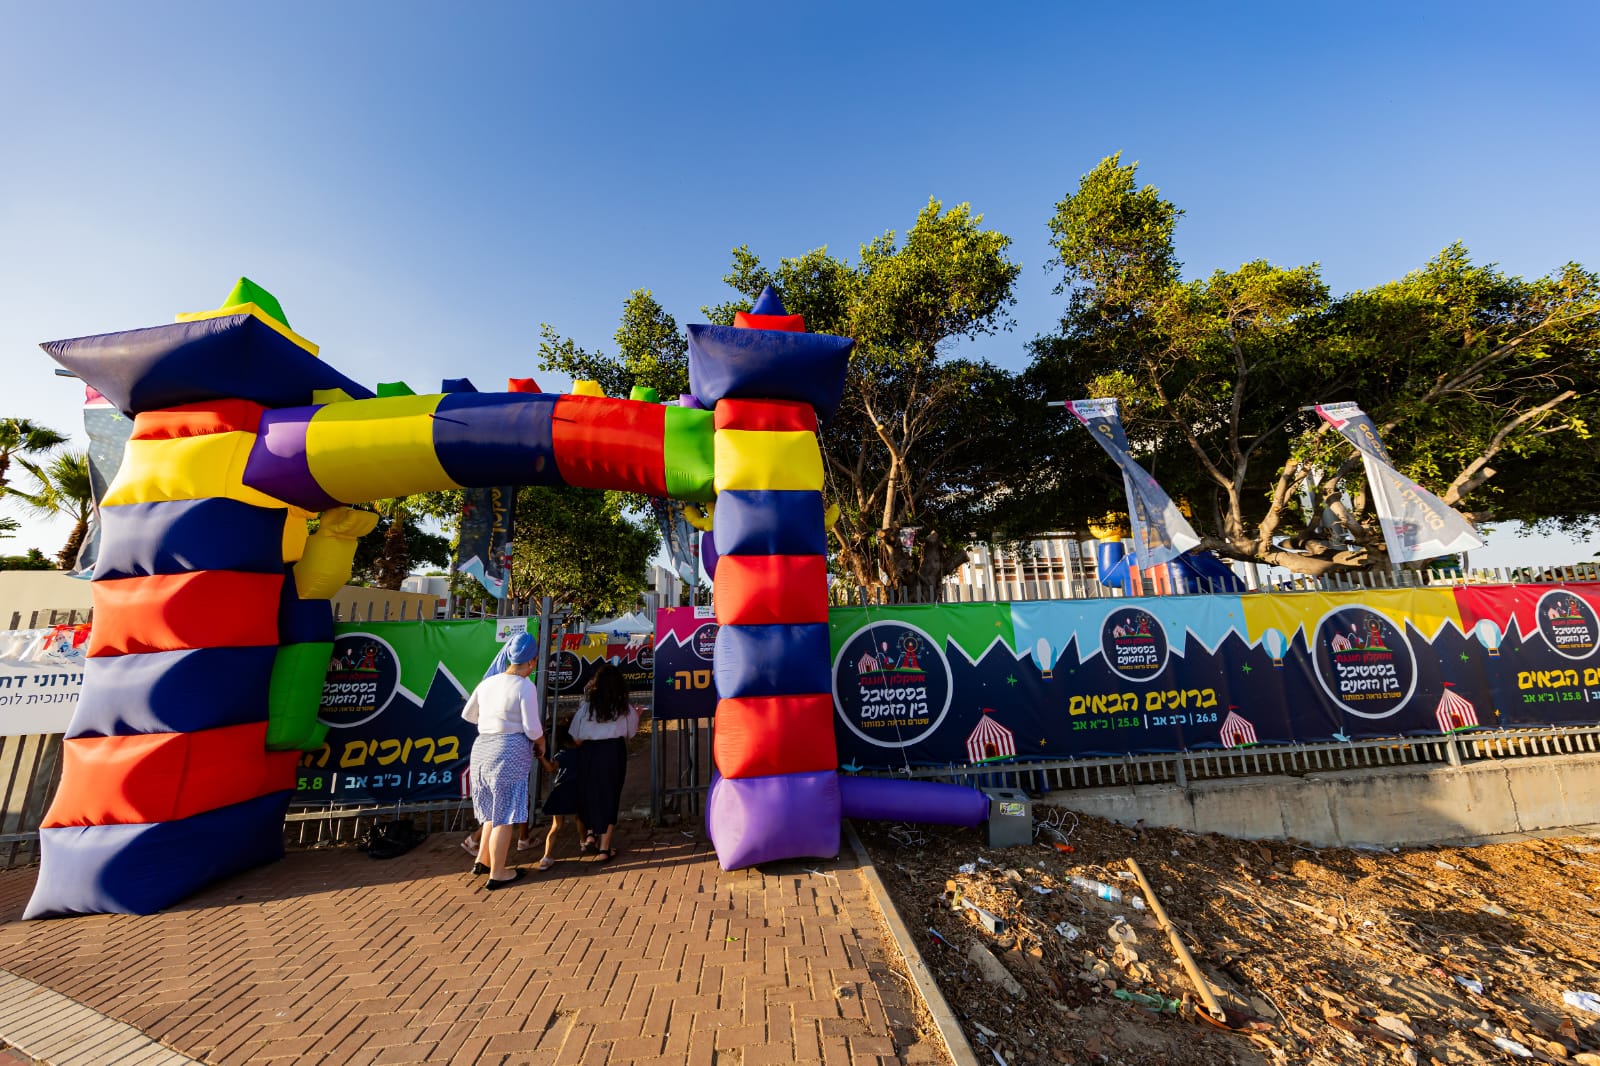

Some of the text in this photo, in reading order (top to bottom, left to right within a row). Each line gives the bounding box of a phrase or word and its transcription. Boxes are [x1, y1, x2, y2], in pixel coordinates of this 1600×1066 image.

[1116, 645, 1156, 654] בפסטיבל
[1147, 655, 1157, 664] בין
[1337, 663, 1396, 678] בפסטיבל
[675, 670, 714, 690] סה
[1341, 678, 1399, 693] בין הזמנים
[1517, 669, 1579, 690] הבאים
[359, 694, 376, 706] בין
[860, 686, 927, 702] בפסטיבל
[1523, 694, 1536, 703] אב
[1561, 691, 1582, 701] 25.8
[1069, 688, 1218, 716] ברוכים הבאים
[861, 703, 928, 719] בין הזמנים
[1196, 713, 1218, 723] 26.8
[1072, 720, 1087, 731] אב
[1118, 718, 1140, 728] 25.8
[1153, 716, 1167, 726] אב
[340, 735, 460, 768] ברוכים
[296, 776, 323, 791] 5.8
[344, 775, 368, 789] אב
[417, 771, 453, 785] 26.8
